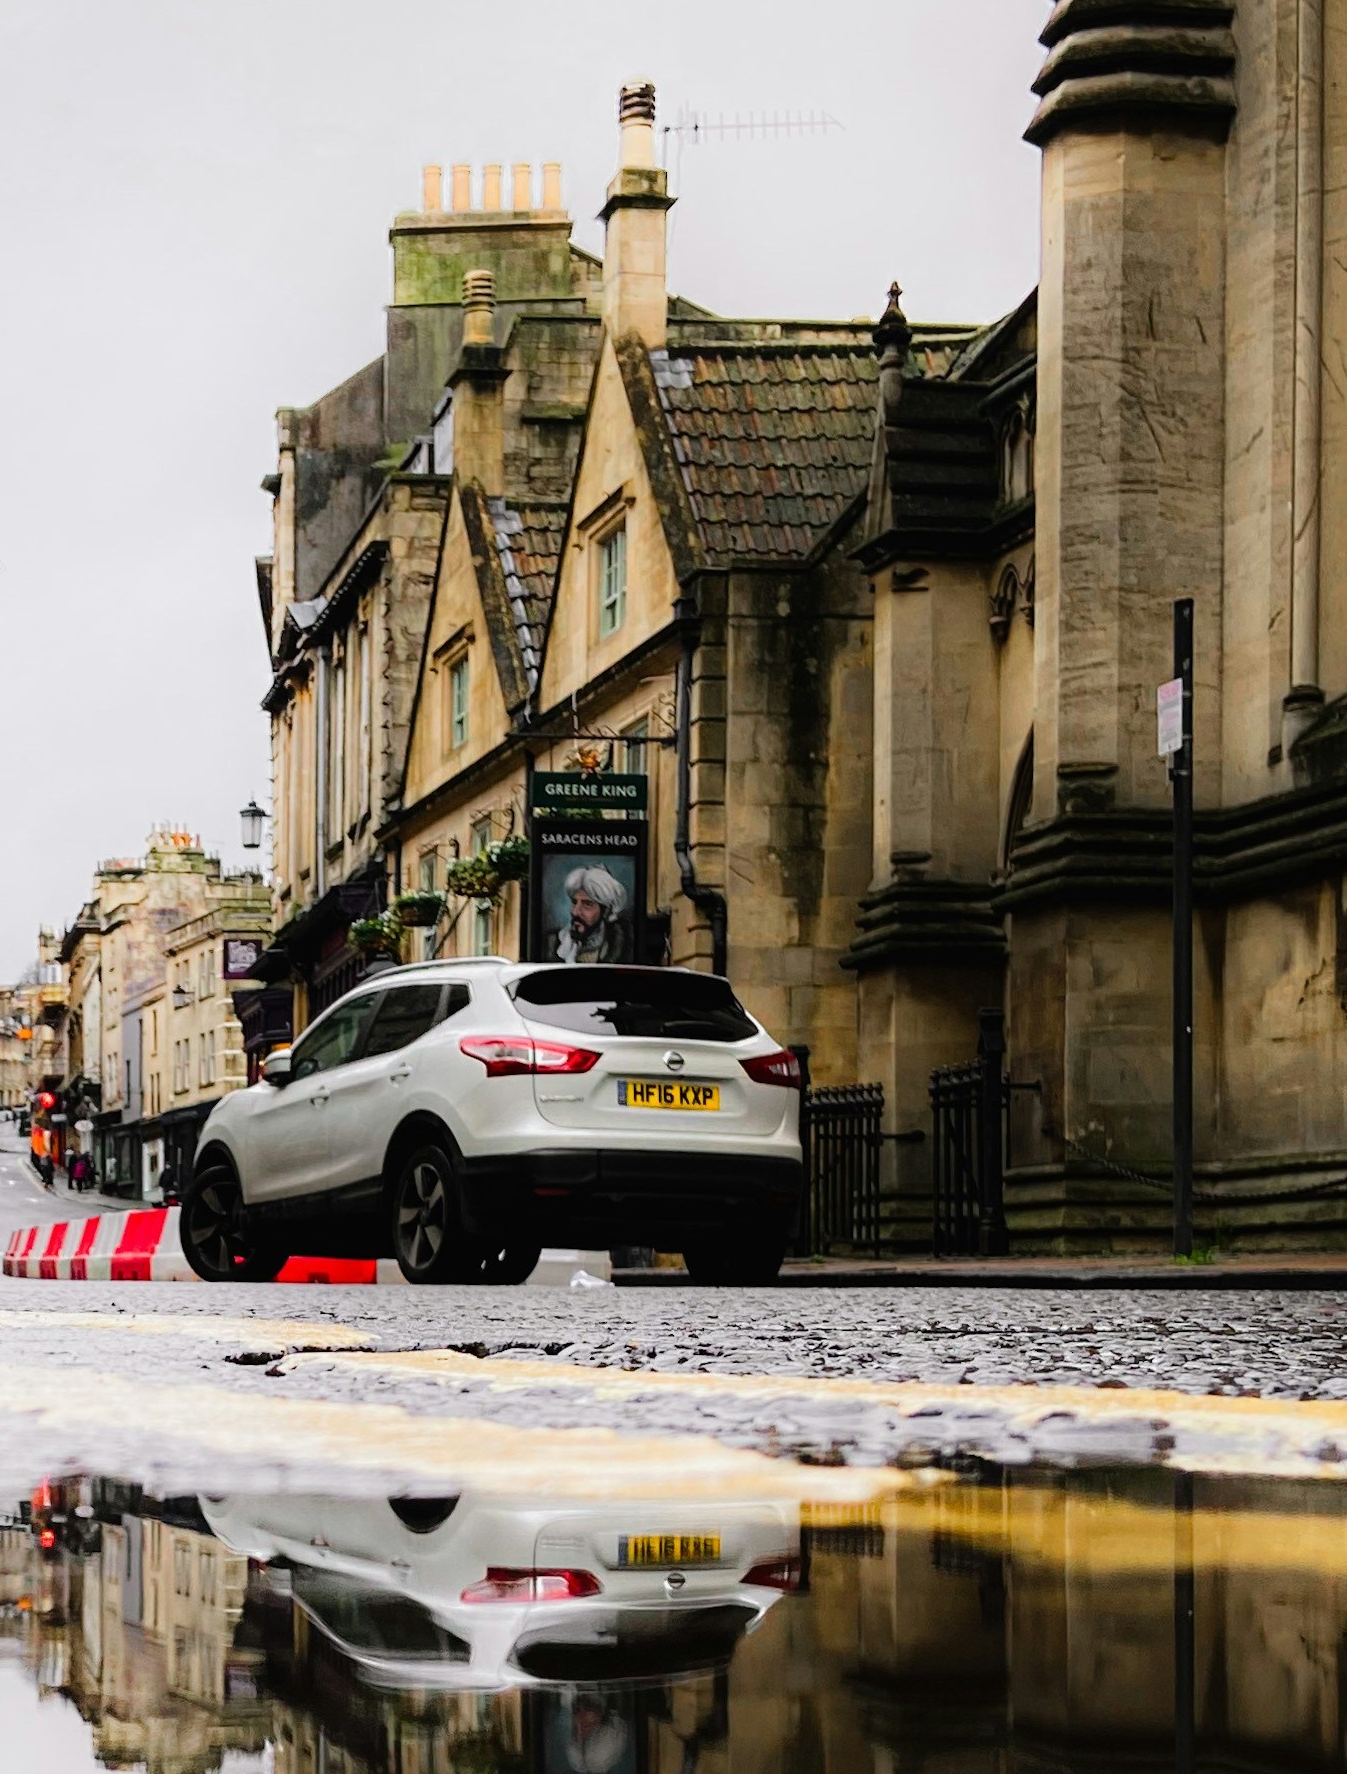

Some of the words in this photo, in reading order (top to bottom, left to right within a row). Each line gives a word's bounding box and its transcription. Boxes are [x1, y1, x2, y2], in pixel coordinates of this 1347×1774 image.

[544, 783, 598, 796] GREENE
[602, 785, 637, 797] KING
[541, 833, 602, 845] SARACENS
[604, 835, 638, 846] HEAD
[633, 1083, 675, 1104] HF16
[679, 1086, 714, 1106] KXP
